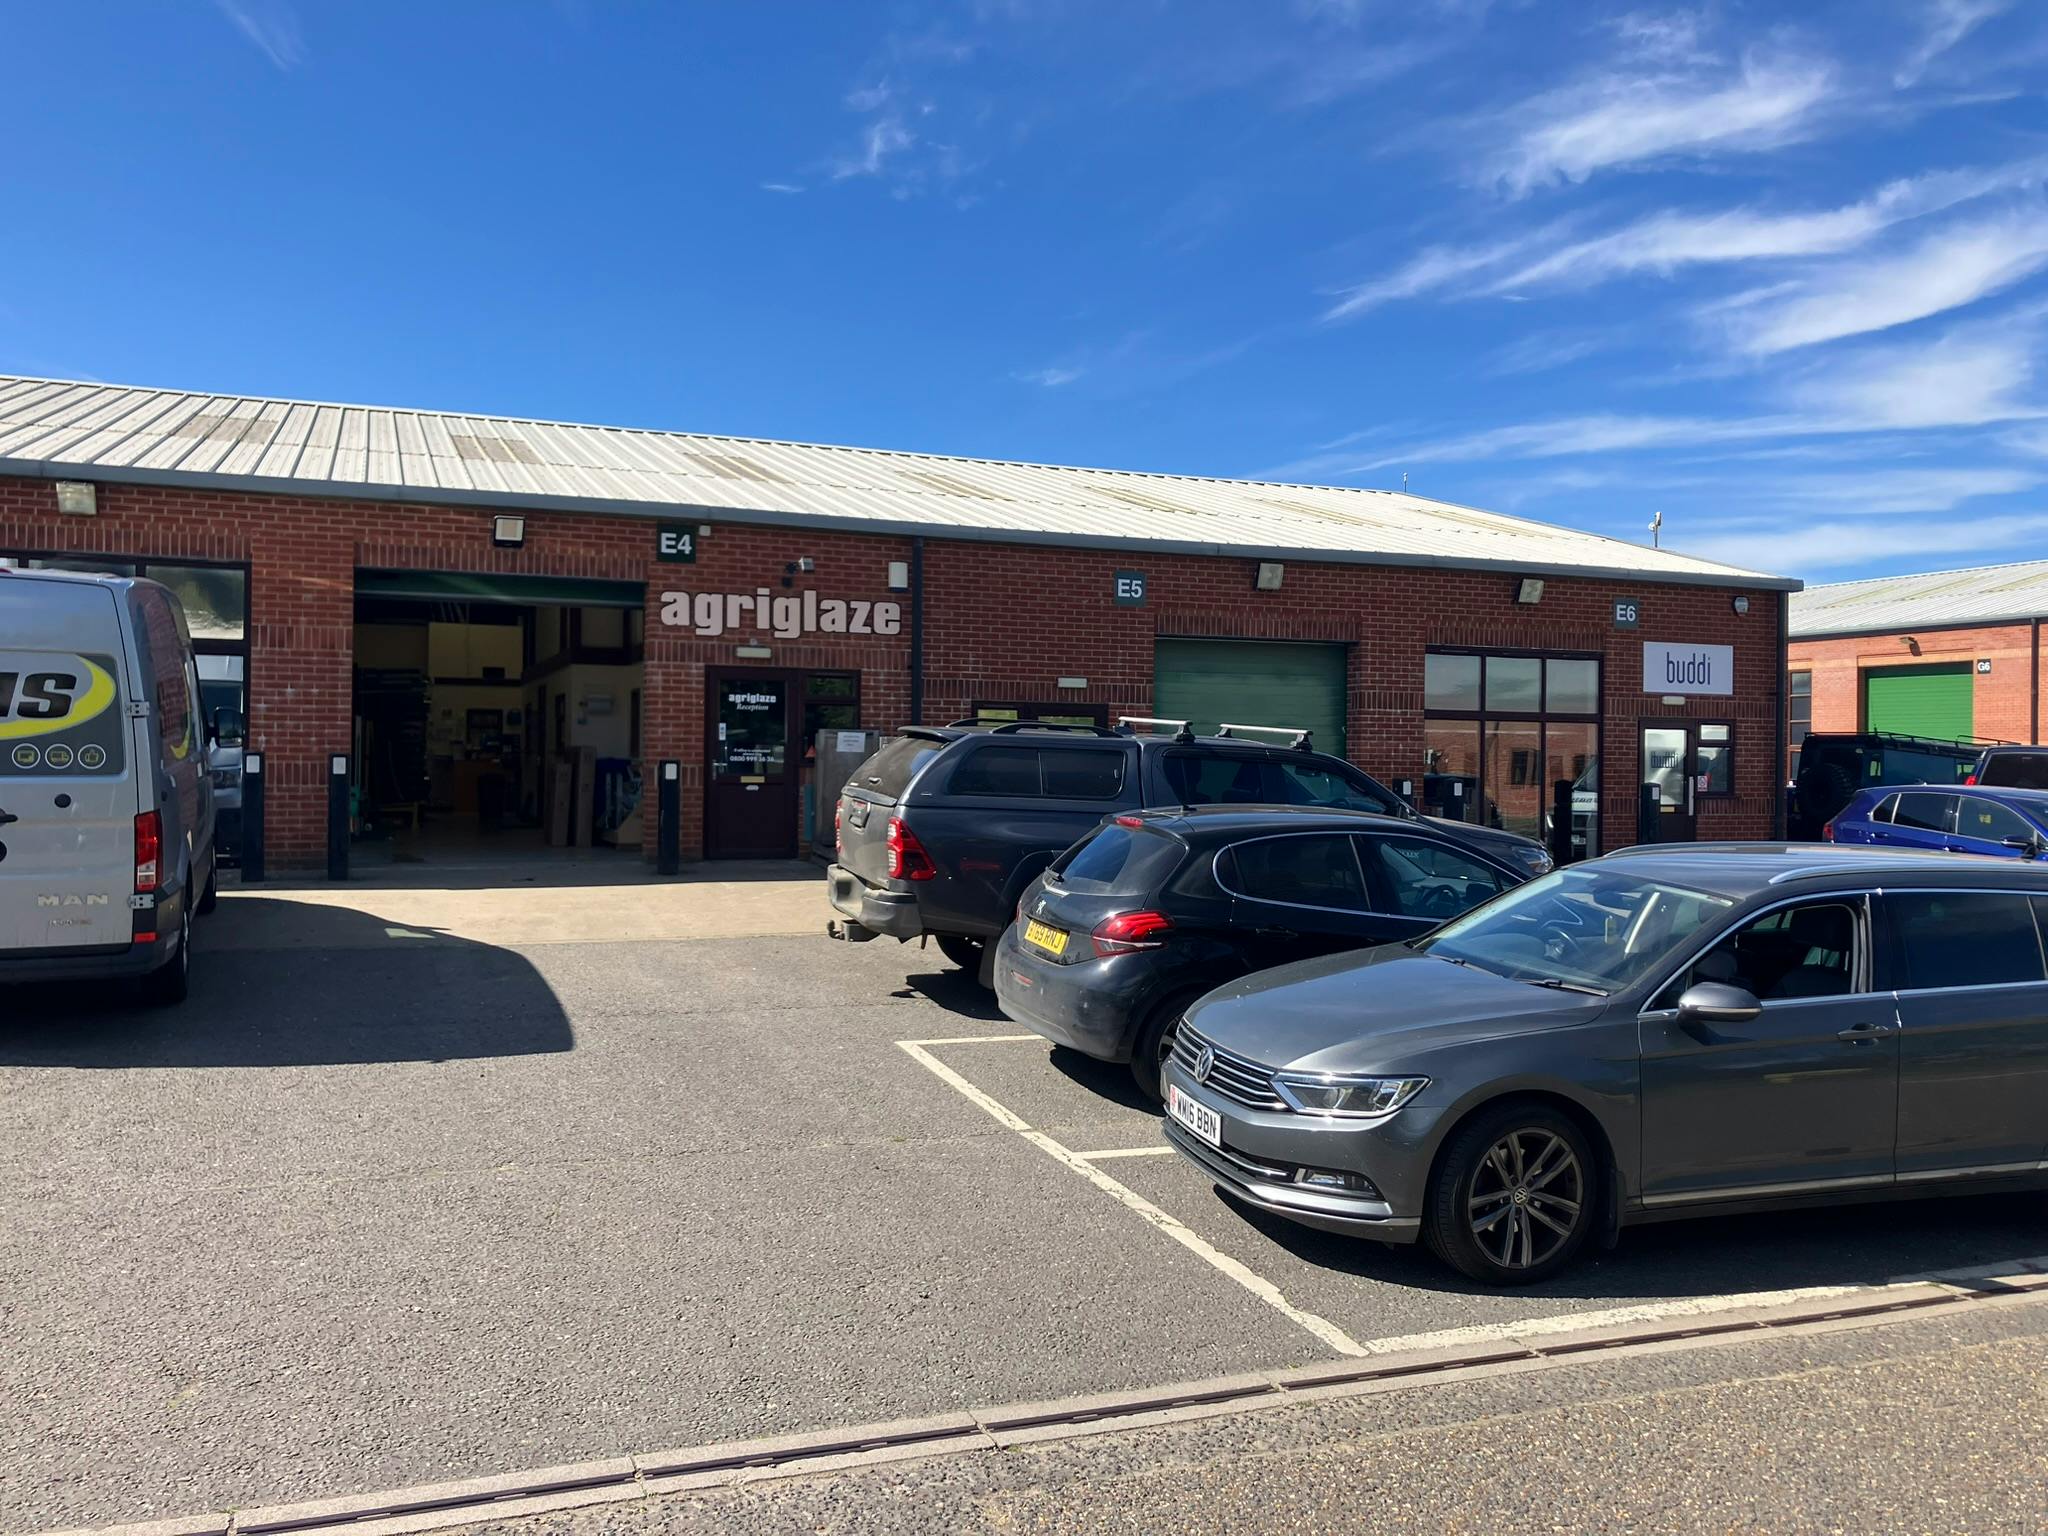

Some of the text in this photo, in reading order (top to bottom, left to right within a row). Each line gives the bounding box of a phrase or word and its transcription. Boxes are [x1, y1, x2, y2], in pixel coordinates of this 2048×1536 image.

[660, 532, 692, 555] E4
[1117, 578, 1142, 598] E5
[660, 587, 901, 639] agriglaze
[1616, 604, 1636, 621] E6
[1666, 651, 1710, 685] buddi
[1977, 661, 1991, 671] G6
[728, 693, 777, 703] agriglaze
[736, 703, 769, 712] Reception
[37, 894, 108, 906] MAN
[1196, 1106, 1218, 1139] BBN
